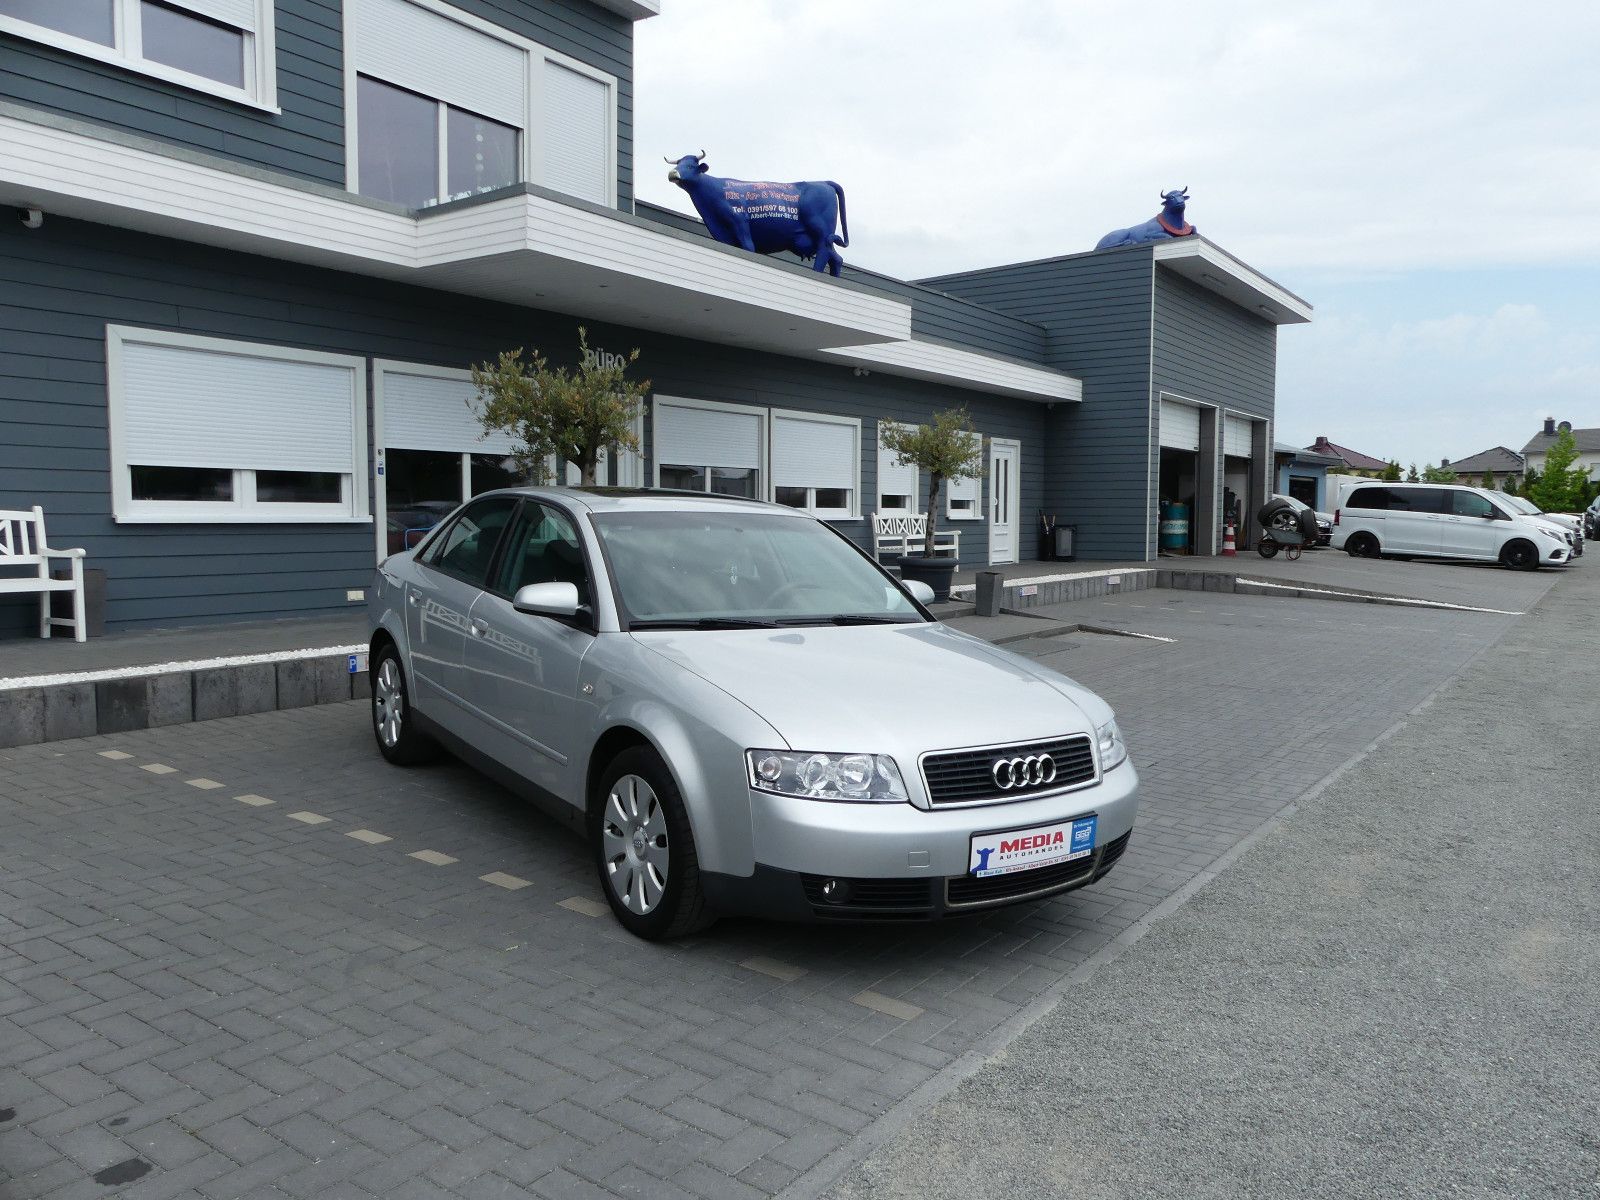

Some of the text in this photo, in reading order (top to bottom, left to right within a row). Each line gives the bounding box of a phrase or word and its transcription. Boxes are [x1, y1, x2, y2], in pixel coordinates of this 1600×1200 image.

[349, 658, 357, 669] P
[999, 830, 1064, 853] MEDIA
[999, 845, 1064, 861] AUTOHANDEL
